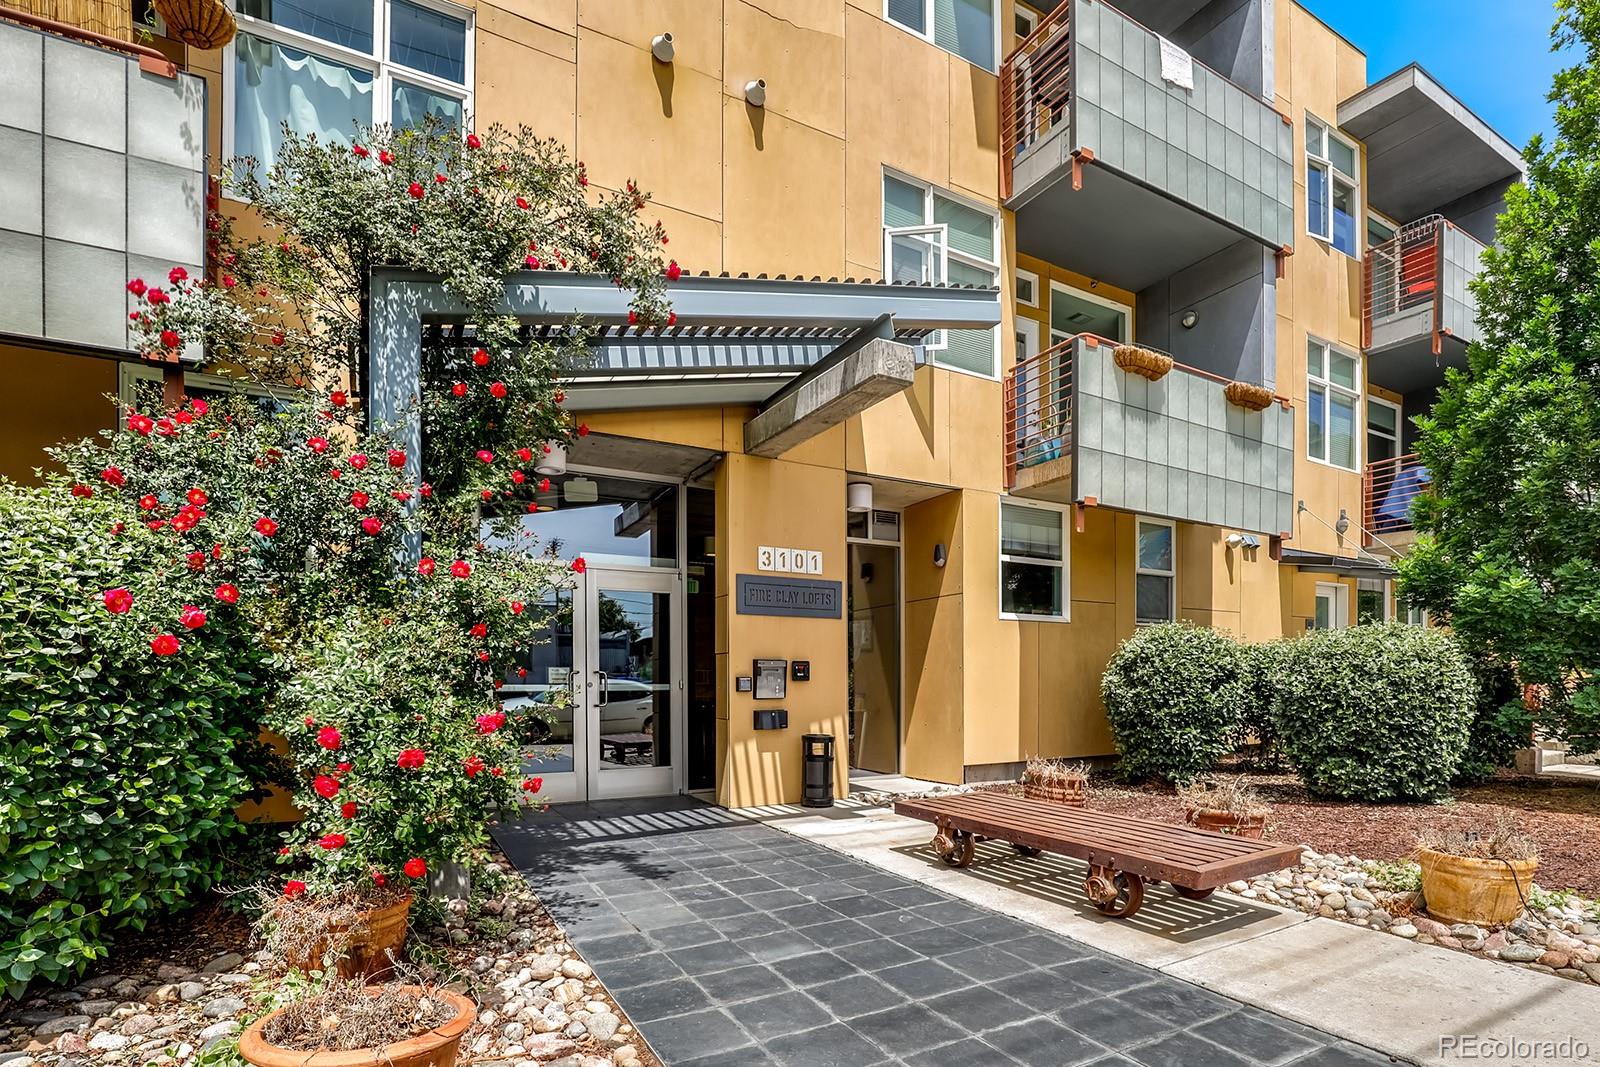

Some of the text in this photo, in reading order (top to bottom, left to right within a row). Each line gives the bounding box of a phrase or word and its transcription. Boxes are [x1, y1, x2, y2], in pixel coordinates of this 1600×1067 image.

[761, 550, 818, 571] 3101
[749, 588, 832, 606] FIRE CLAY LOFTS
